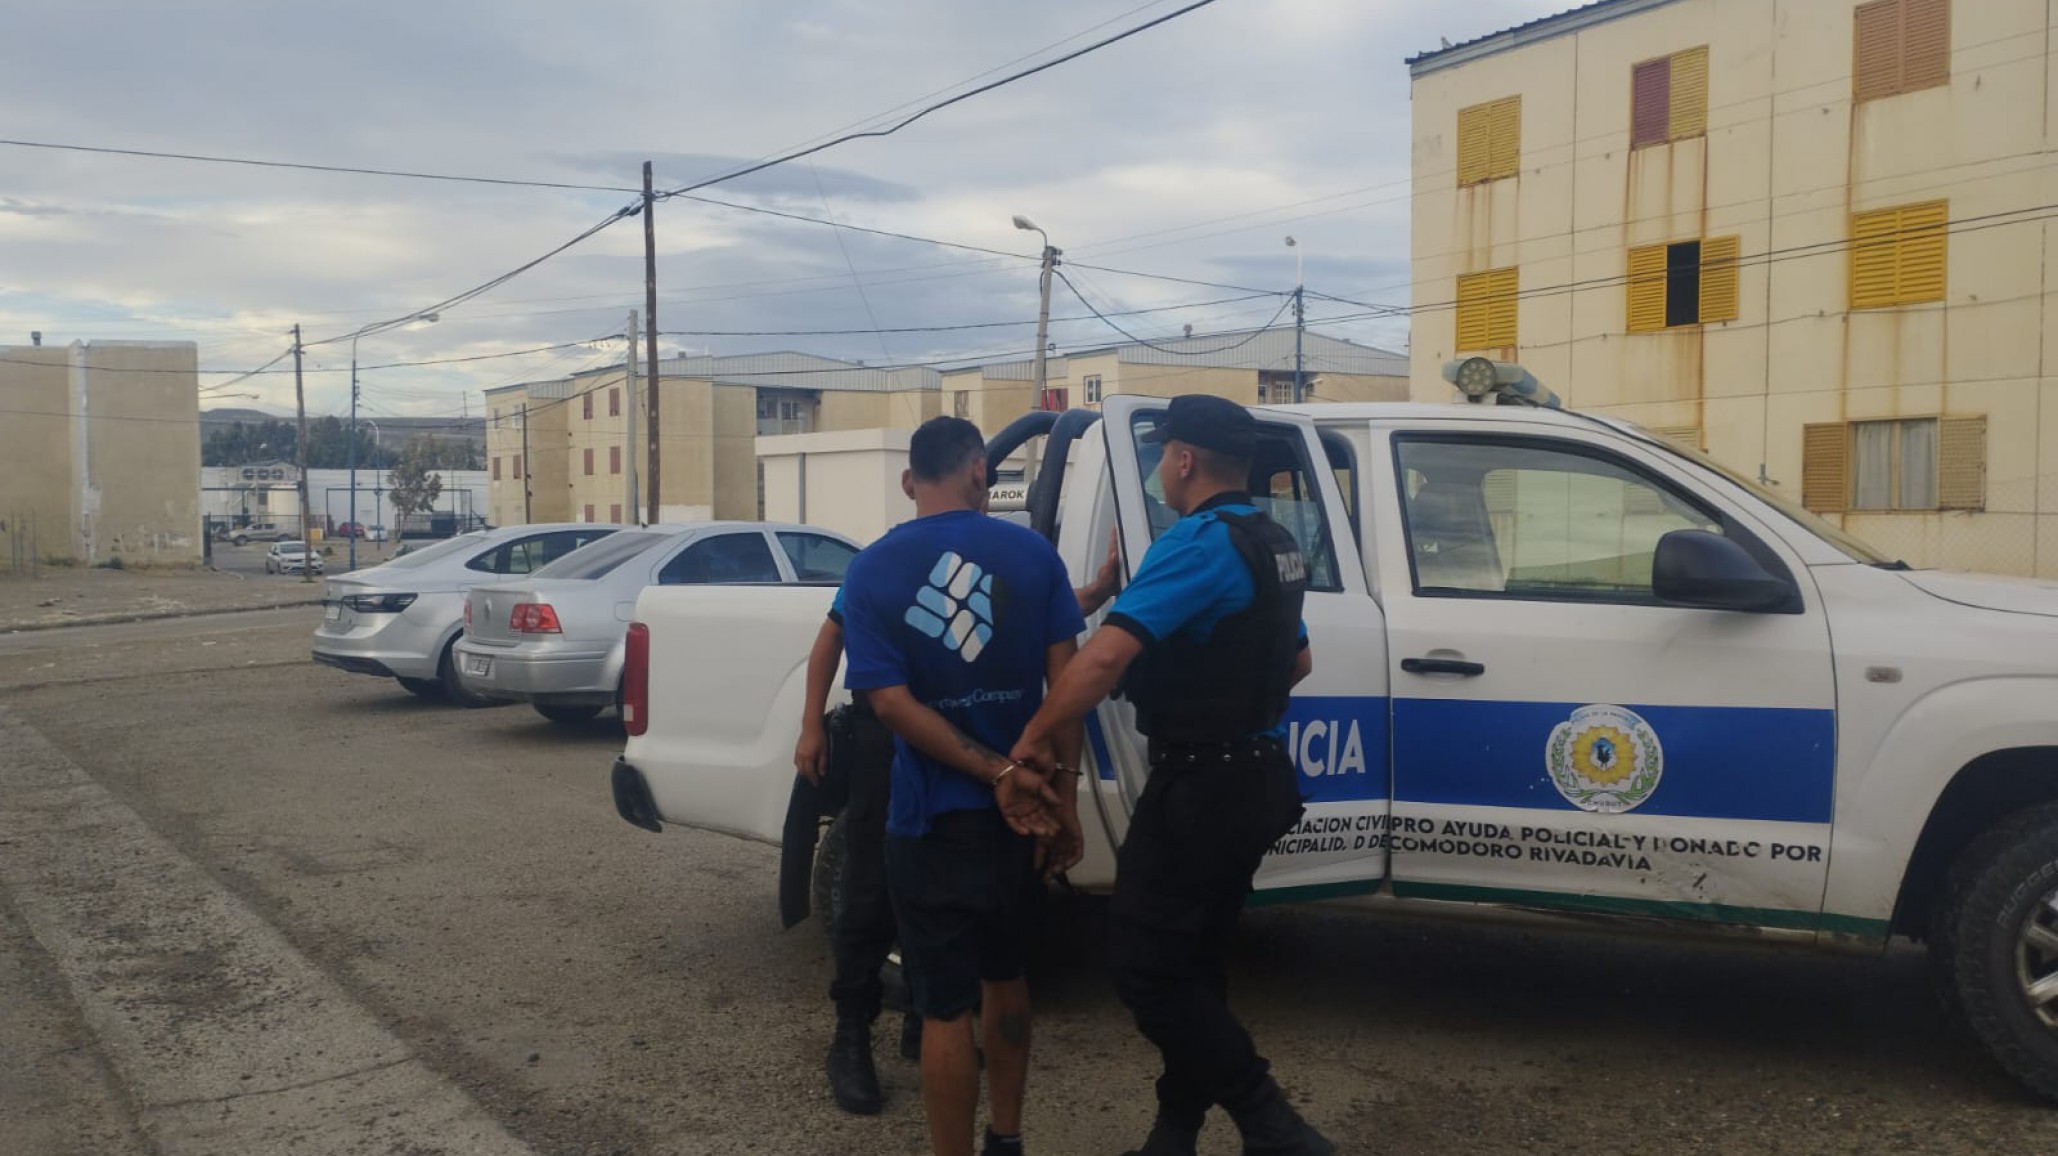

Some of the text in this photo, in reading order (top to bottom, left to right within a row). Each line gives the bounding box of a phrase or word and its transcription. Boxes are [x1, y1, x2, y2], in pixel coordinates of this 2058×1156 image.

[1288, 719, 1366, 778] ICIA
[1391, 815, 1434, 834] PRO
[1442, 820, 1512, 840] AYUDA
[1770, 842, 1822, 862] POR
[1391, 836, 1523, 860] COMODORO
[1529, 846, 1652, 871] RIVADAVIA
